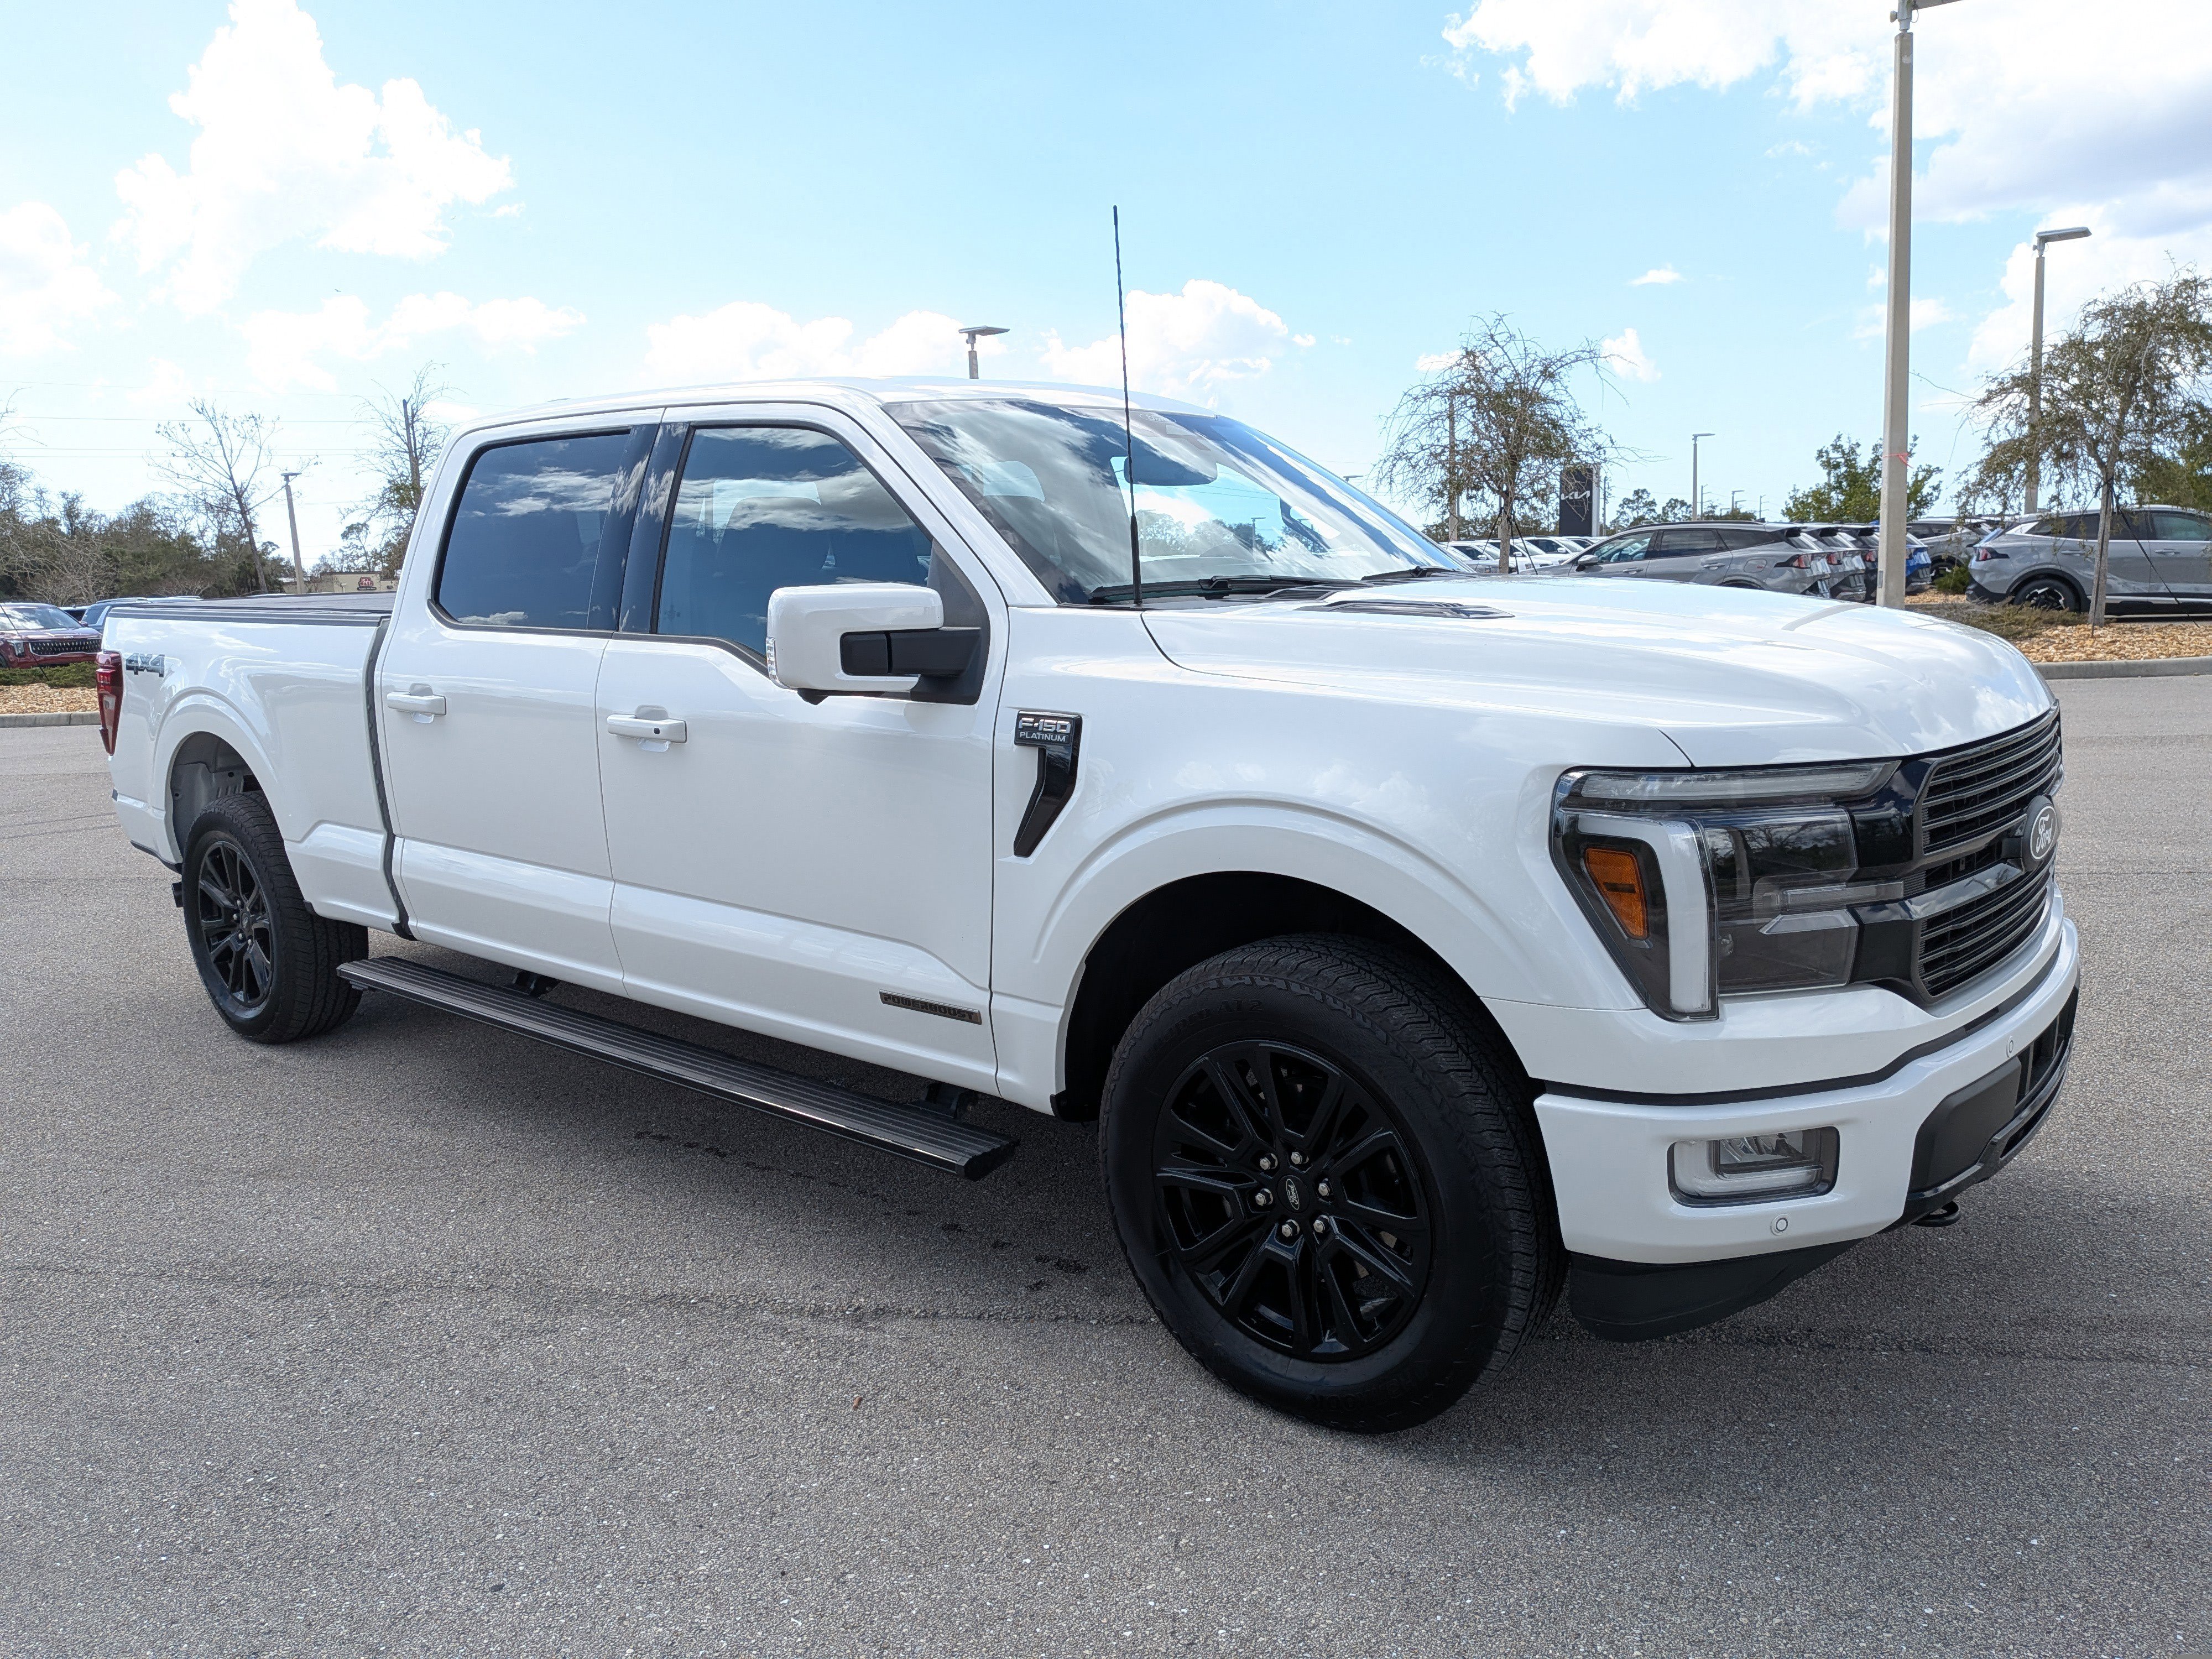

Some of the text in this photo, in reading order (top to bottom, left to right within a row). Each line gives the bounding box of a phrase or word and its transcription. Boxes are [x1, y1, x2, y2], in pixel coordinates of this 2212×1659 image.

[1018, 717, 1071, 733] F-150
[1019, 731, 1066, 742] PLATINUM
[2036, 813, 2053, 853] Ford
[883, 994, 974, 1020] POWERBOOST
